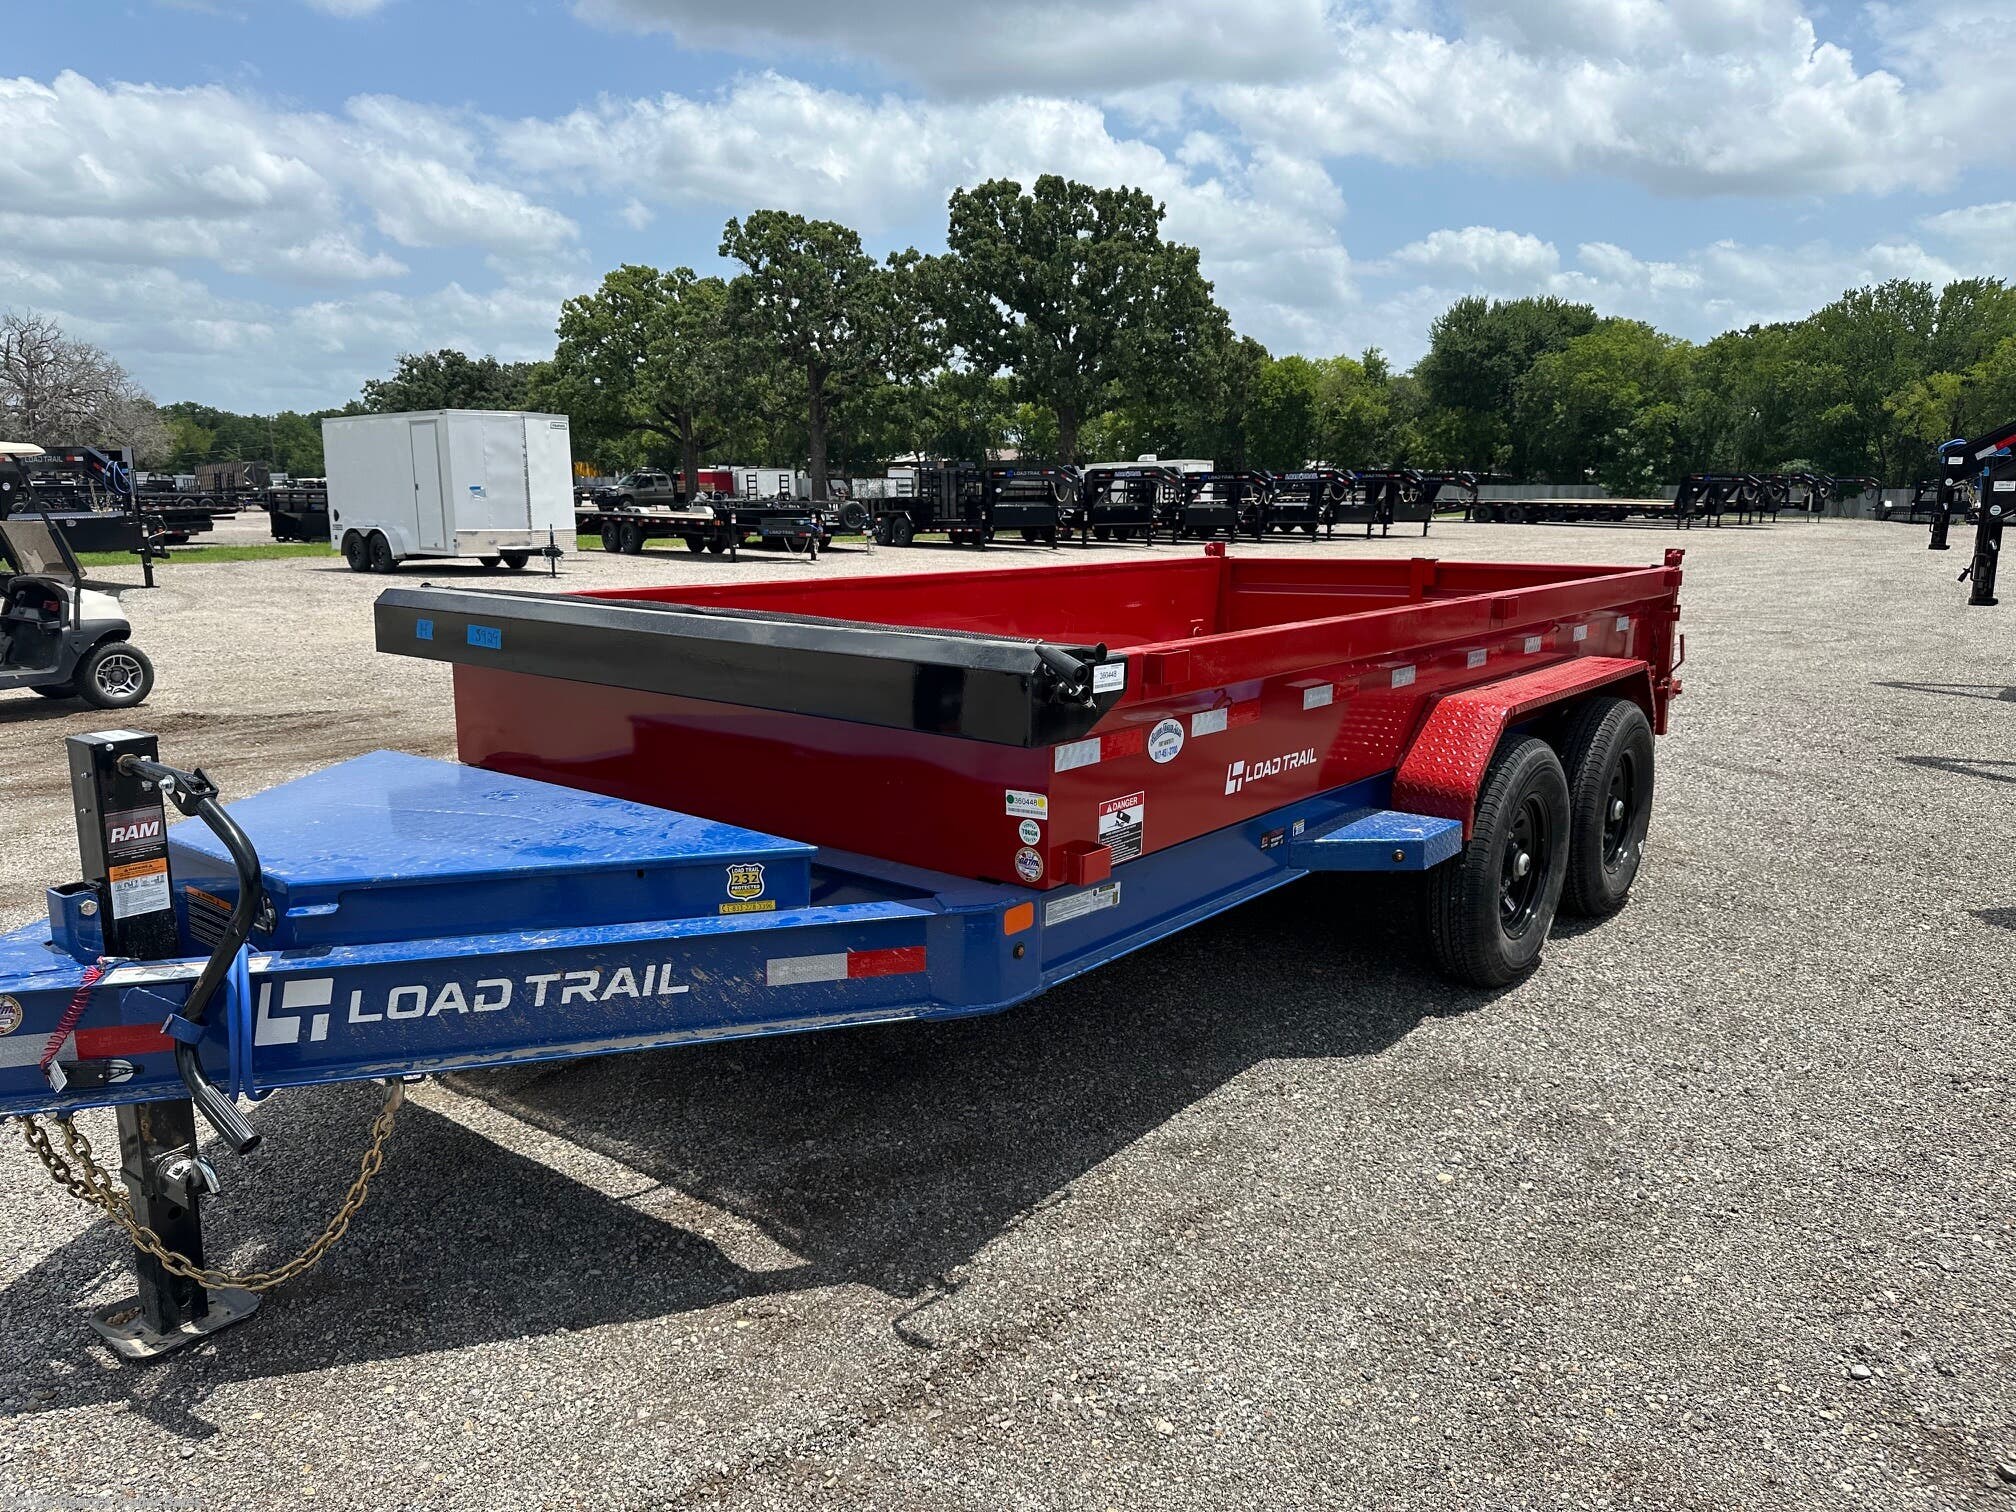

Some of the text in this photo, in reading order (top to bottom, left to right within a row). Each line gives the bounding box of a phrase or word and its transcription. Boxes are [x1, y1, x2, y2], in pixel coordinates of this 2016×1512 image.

[1245, 747, 1317, 783] LOAD TRAIL
[1112, 796, 1138, 811] DANGER
[110, 820, 160, 844] RAM
[734, 874, 758, 884] 232
[348, 963, 690, 1023] LOAD TRAIL
